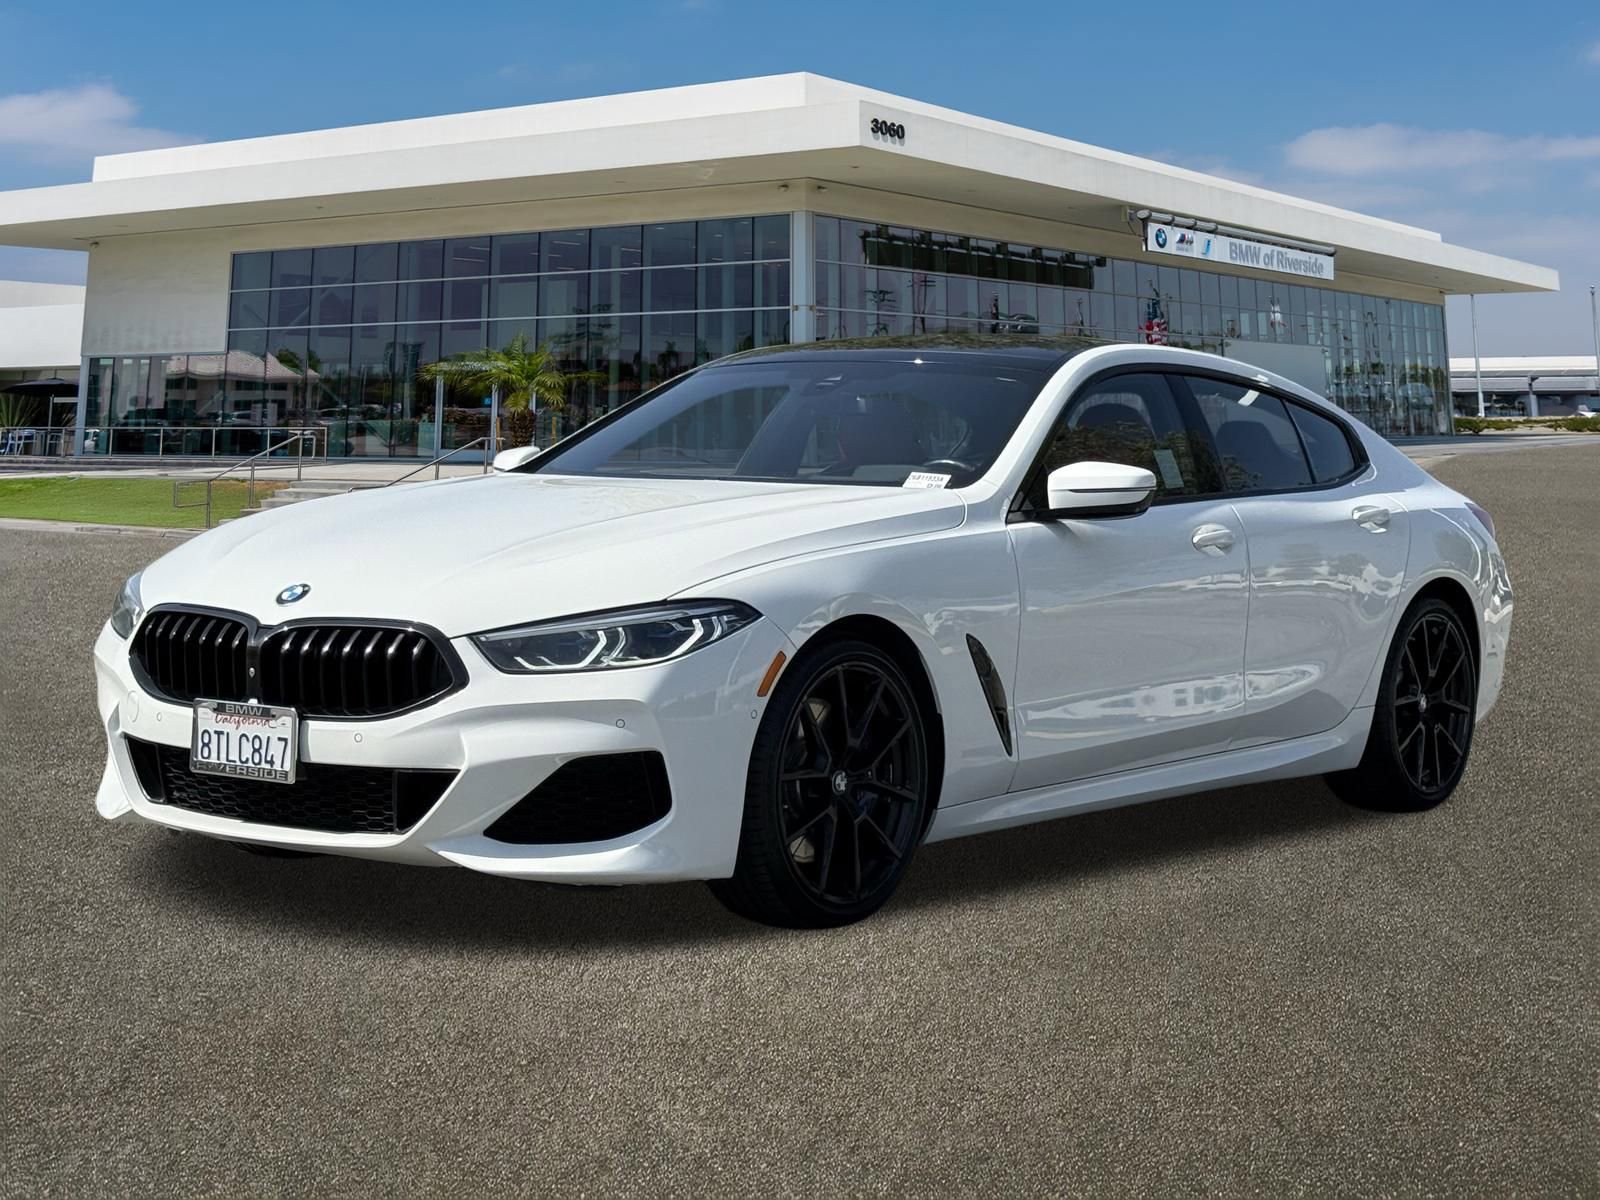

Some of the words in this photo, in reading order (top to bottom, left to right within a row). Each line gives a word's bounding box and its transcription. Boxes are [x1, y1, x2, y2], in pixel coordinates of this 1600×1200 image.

[871, 118, 905, 139] 3060
[1229, 241, 1261, 265] BMW
[1263, 249, 1275, 266] of
[1276, 250, 1324, 274] Riverside
[225, 704, 263, 715] BMW
[215, 713, 277, 730] California
[200, 729, 288, 769] 8TLC847
